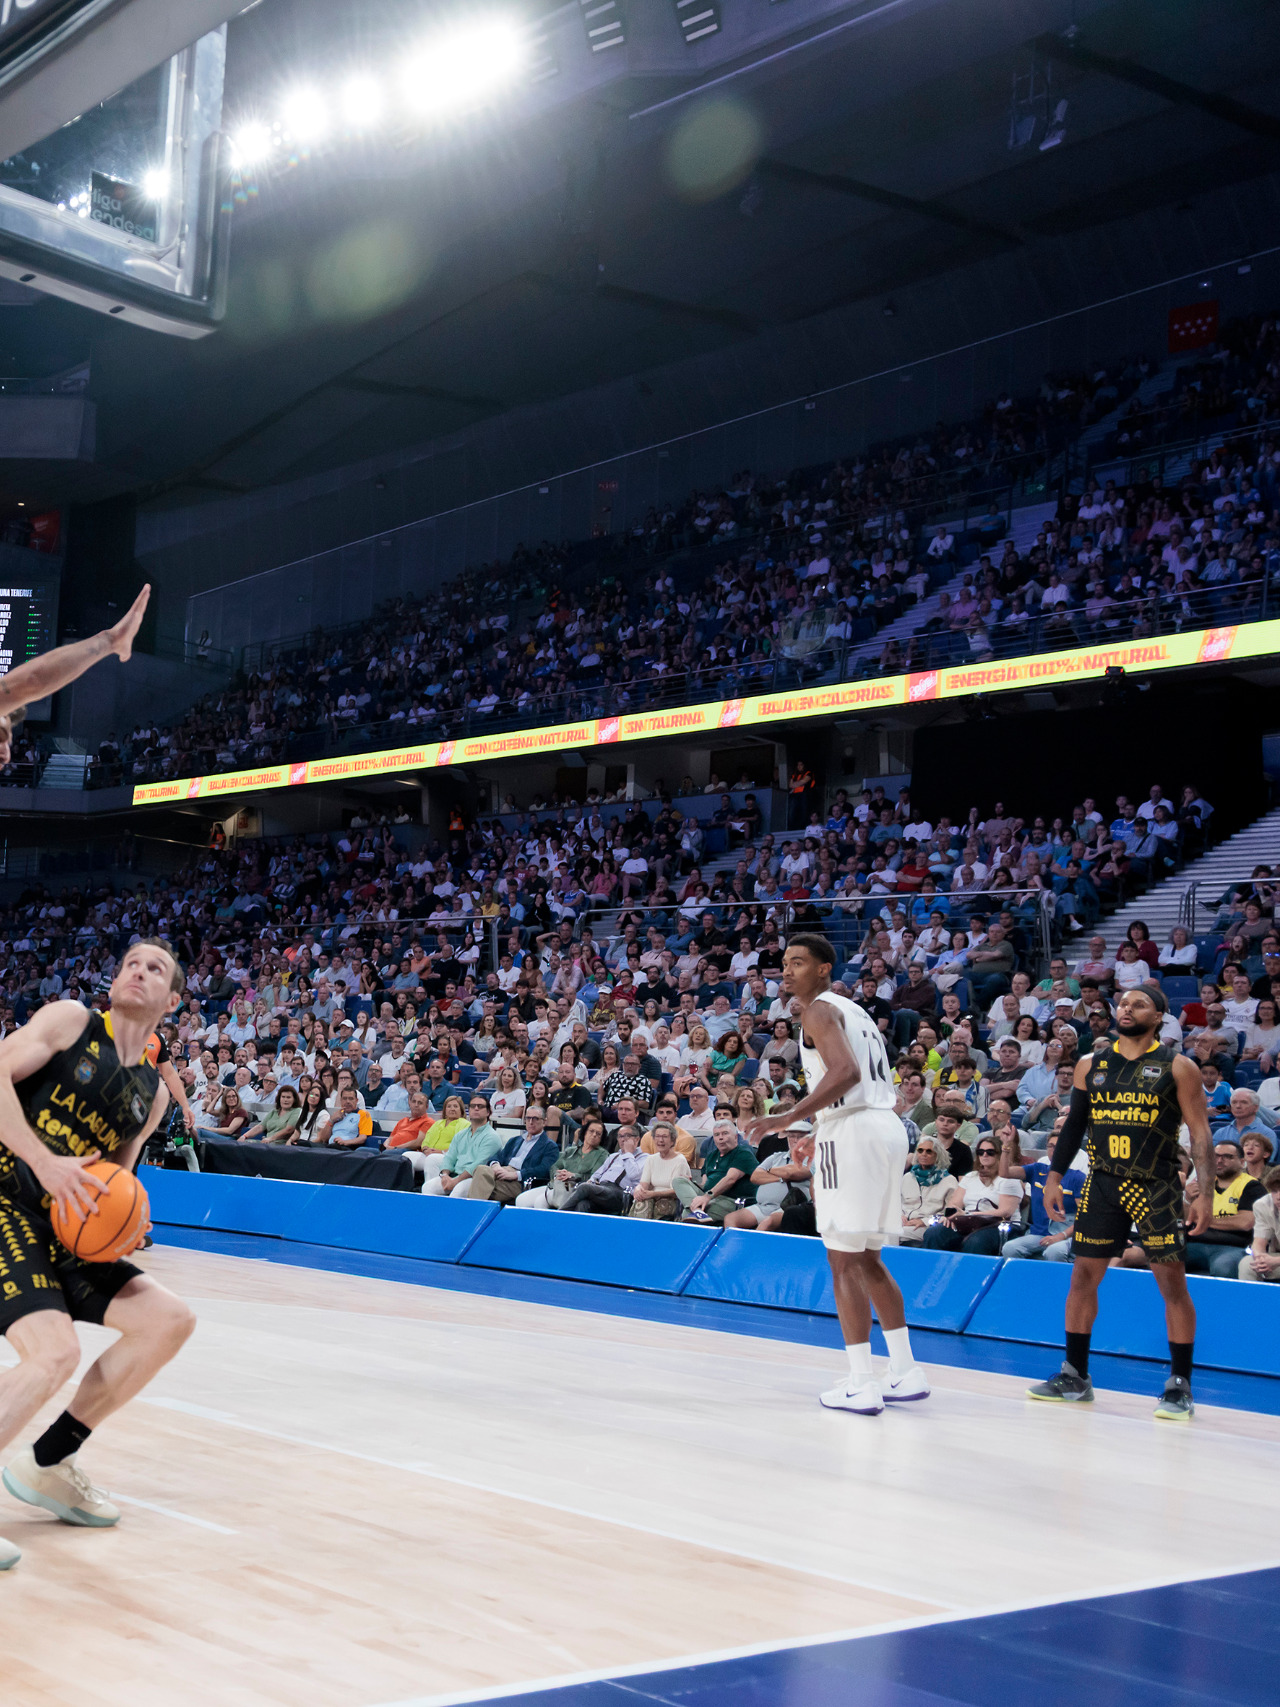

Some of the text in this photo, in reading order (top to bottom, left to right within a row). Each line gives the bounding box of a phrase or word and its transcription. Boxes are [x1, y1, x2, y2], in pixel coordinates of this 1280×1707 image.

[50, 1083, 76, 1113] LA
[76, 1100, 121, 1152] LAGUN
[1106, 1091, 1160, 1106] LAGUNA
